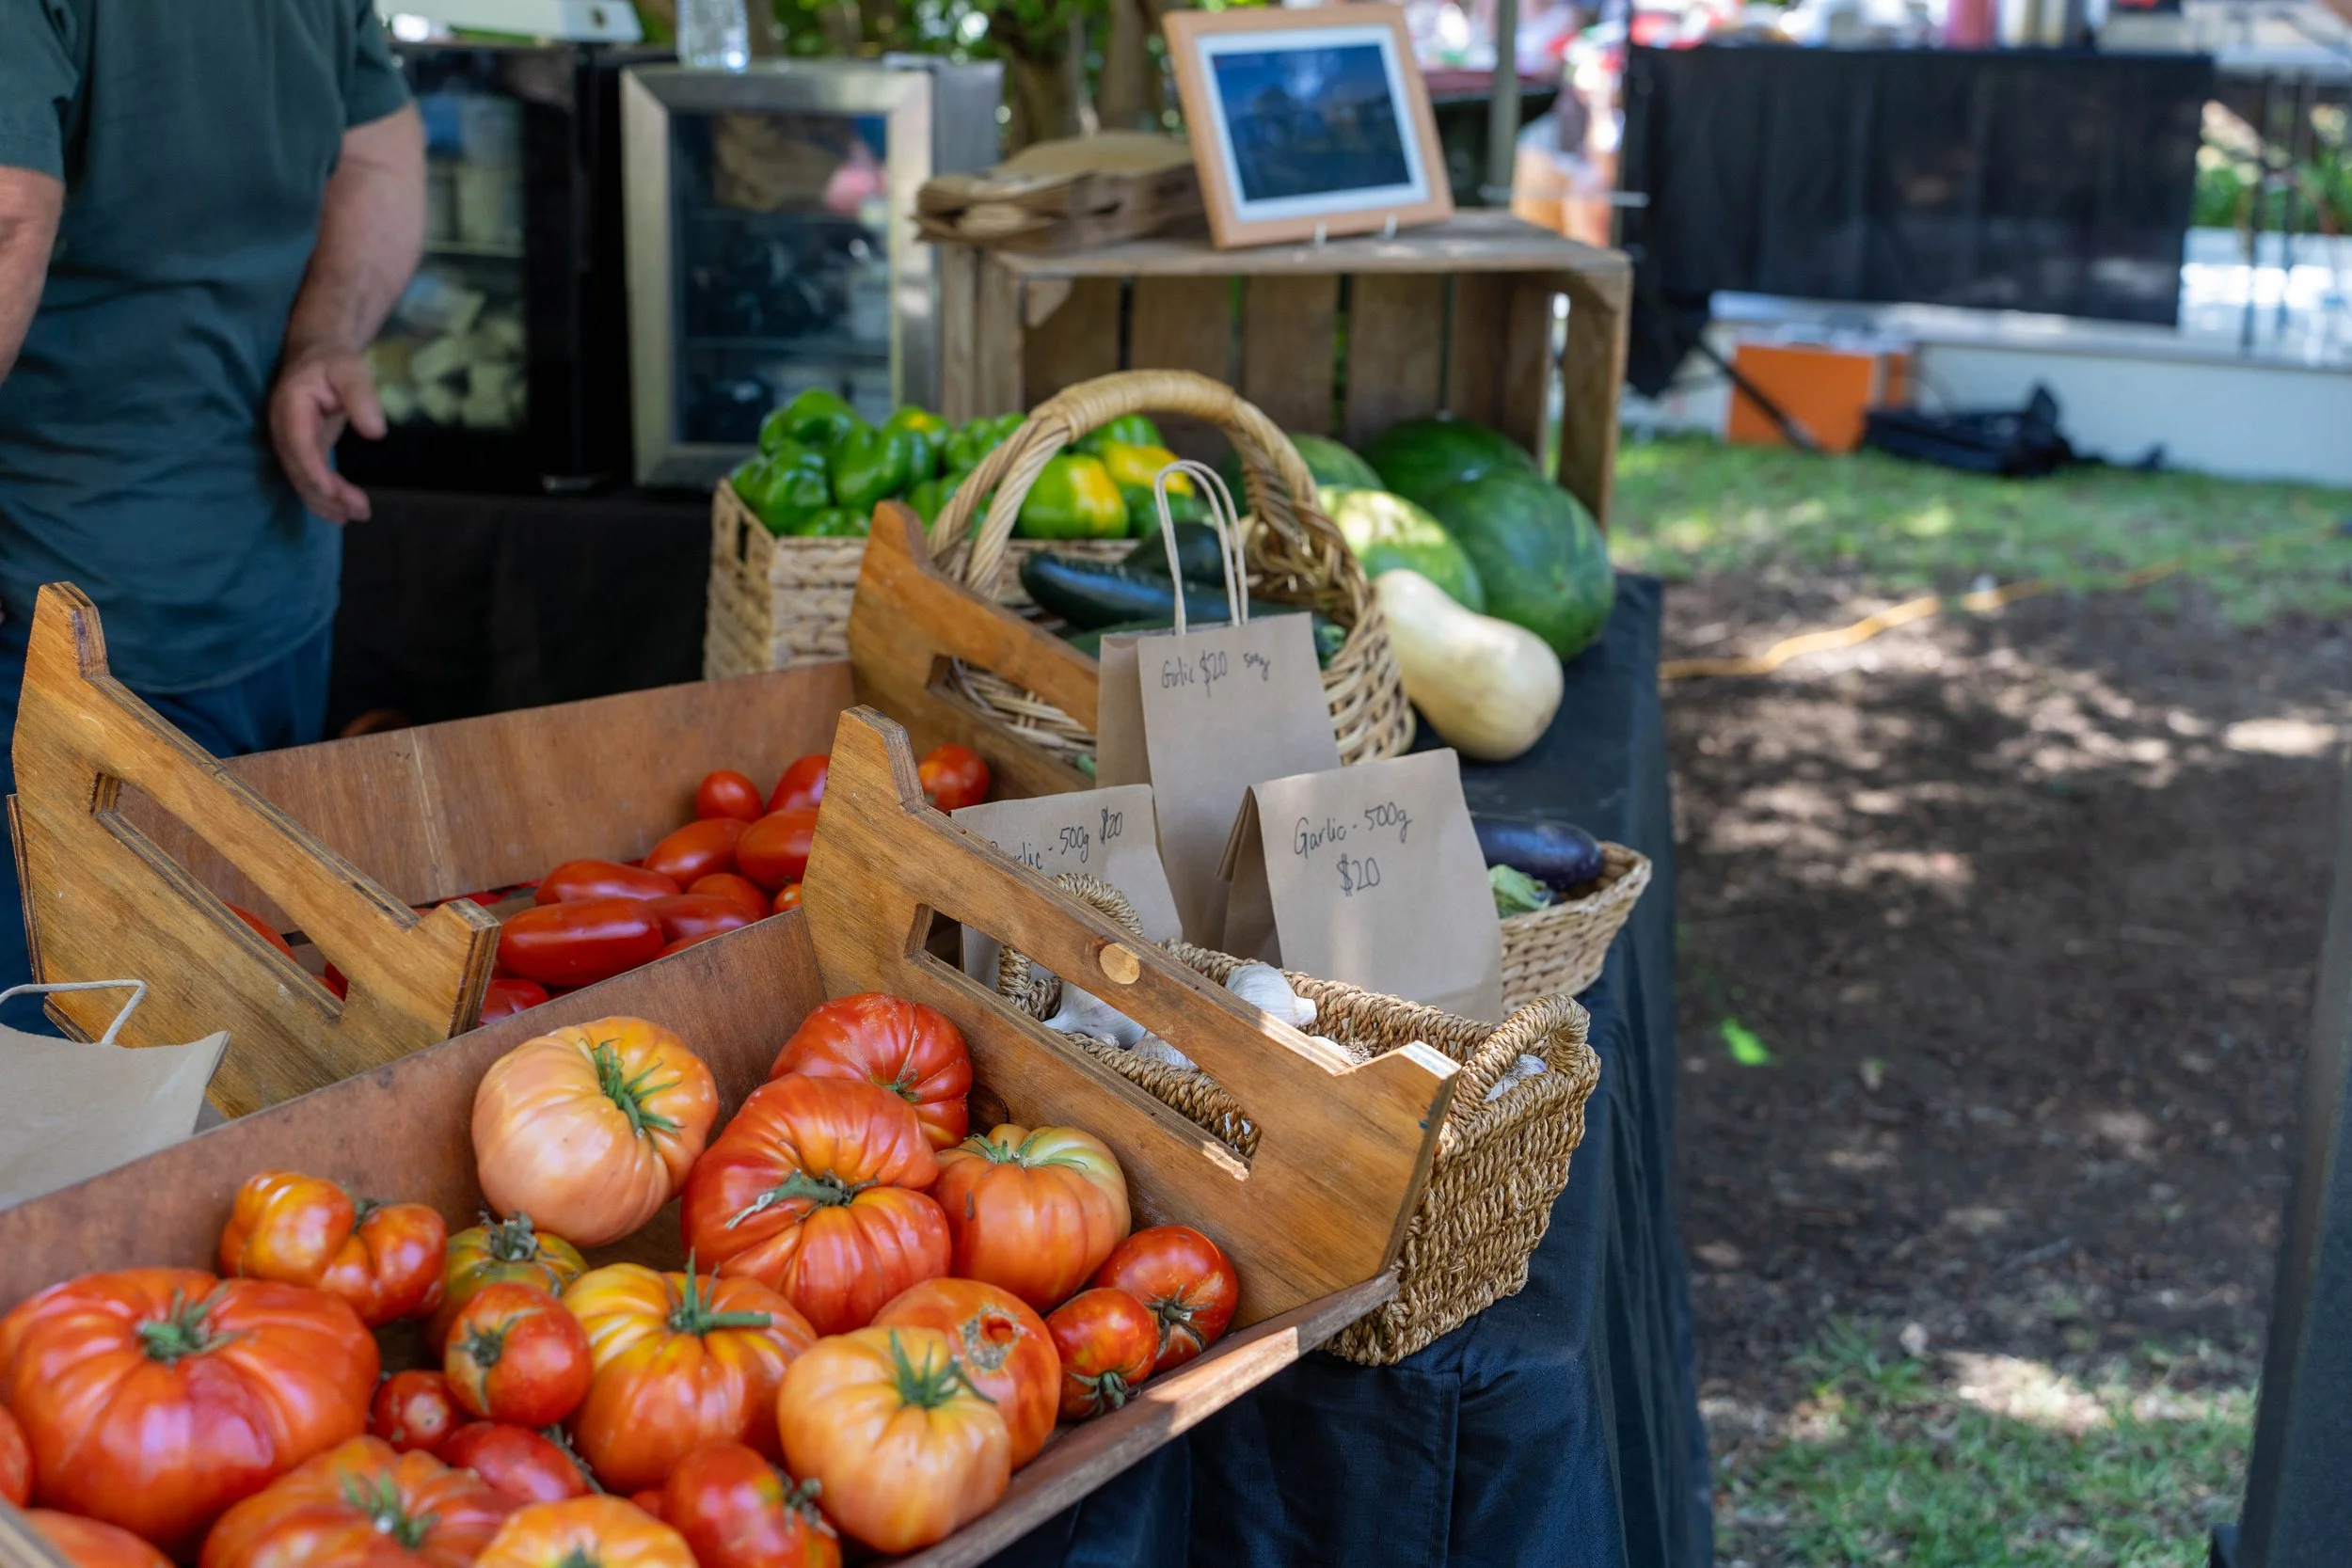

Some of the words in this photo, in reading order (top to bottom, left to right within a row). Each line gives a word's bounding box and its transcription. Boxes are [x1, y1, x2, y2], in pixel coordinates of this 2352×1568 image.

[1199, 649, 1229, 698] $20
[1059, 825, 1089, 863] 500g
[1099, 805, 1124, 847] $20
[1294, 816, 1347, 859] Garlic
[1364, 800, 1413, 844] 500g
[1336, 852, 1381, 897] $20
